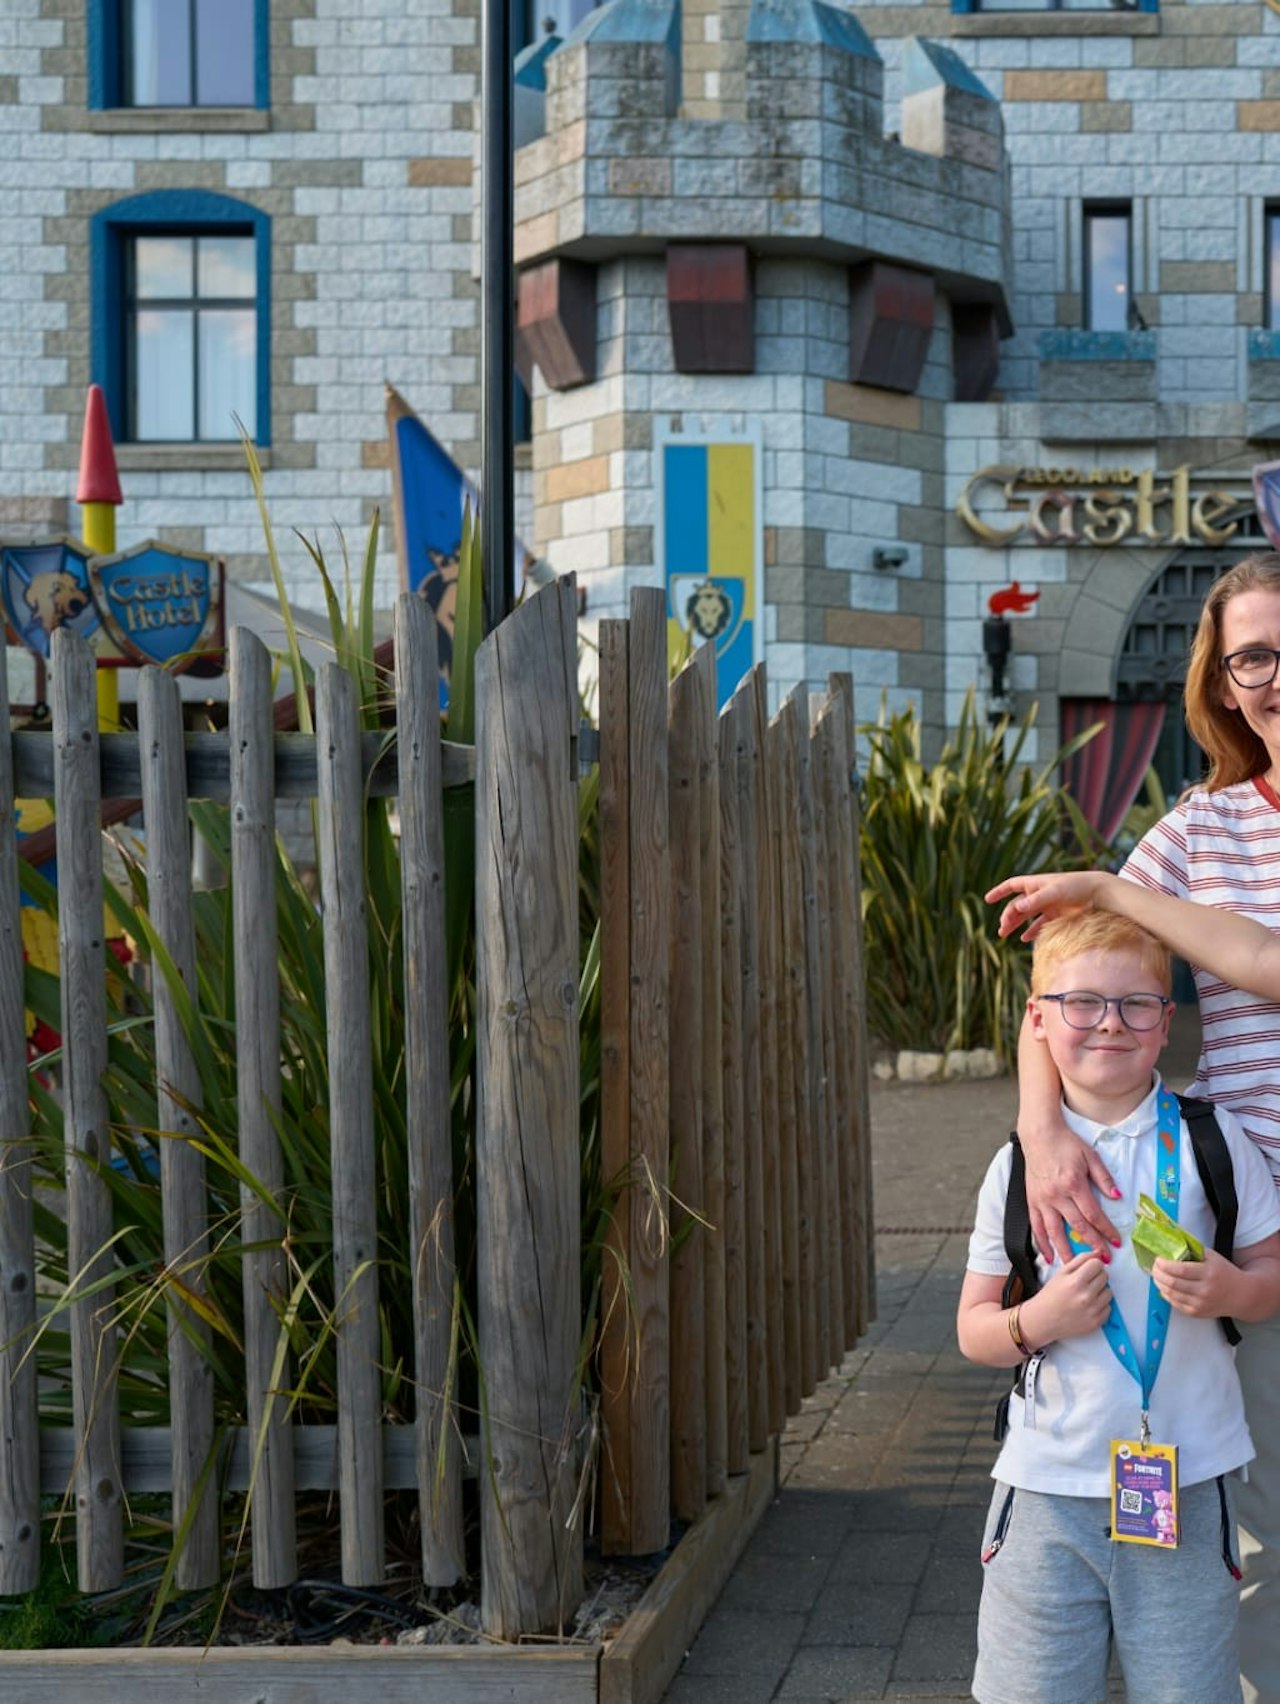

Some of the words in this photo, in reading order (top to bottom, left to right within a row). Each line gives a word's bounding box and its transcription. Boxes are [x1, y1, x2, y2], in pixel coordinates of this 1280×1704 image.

[1022, 466, 1135, 484] LEGOLAND
[957, 465, 1238, 545] Castle
[110, 572, 205, 604] Castle
[126, 600, 201, 631] Hotel
